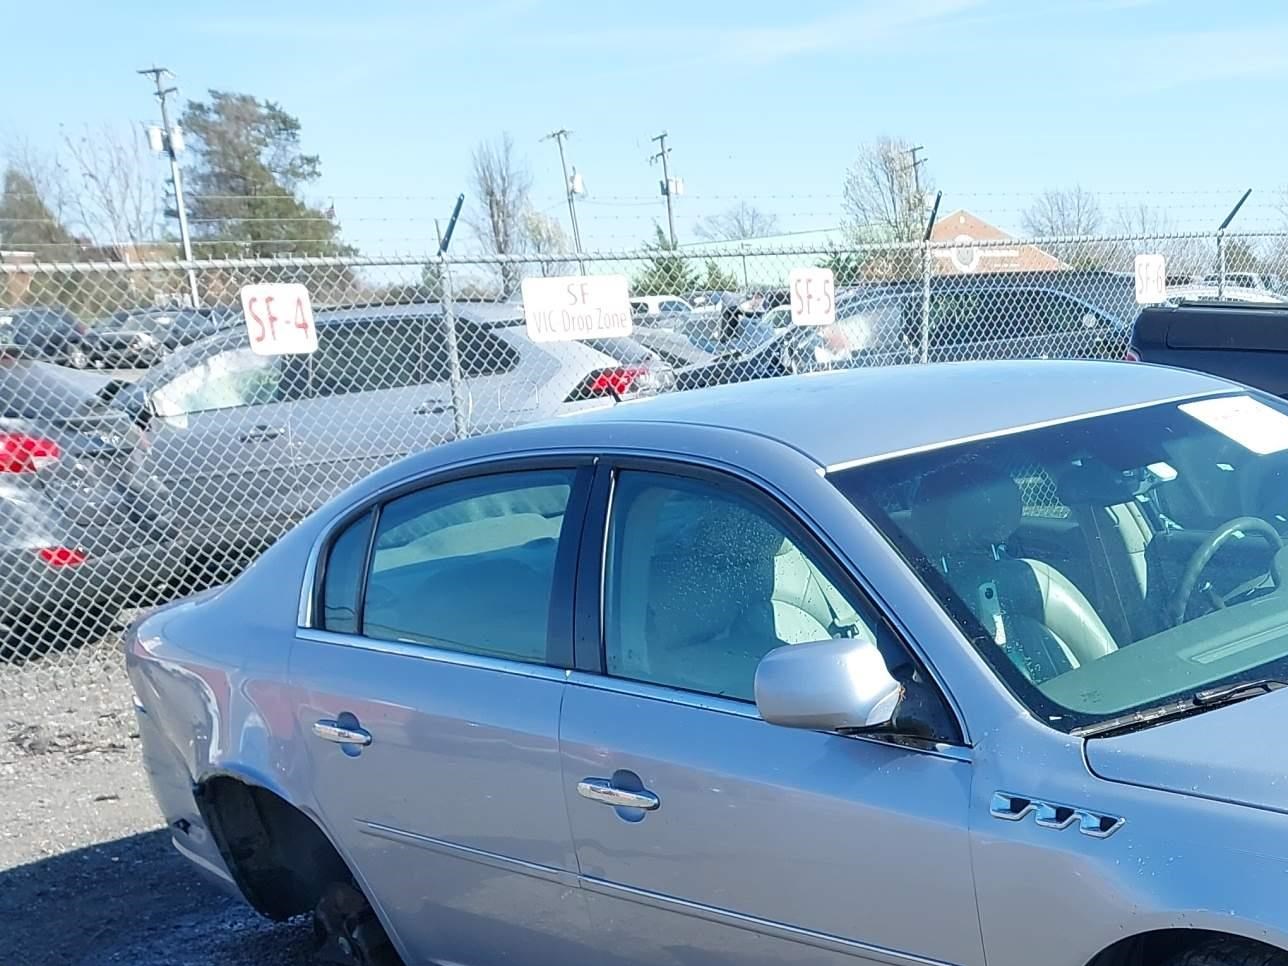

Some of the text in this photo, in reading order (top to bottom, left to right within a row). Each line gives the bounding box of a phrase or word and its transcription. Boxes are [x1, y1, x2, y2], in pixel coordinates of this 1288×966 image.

[567, 282, 590, 306] SF
[795, 278, 831, 315] SF-5
[249, 296, 309, 342] SF-4
[533, 307, 628, 334] VIC Drop Zone
